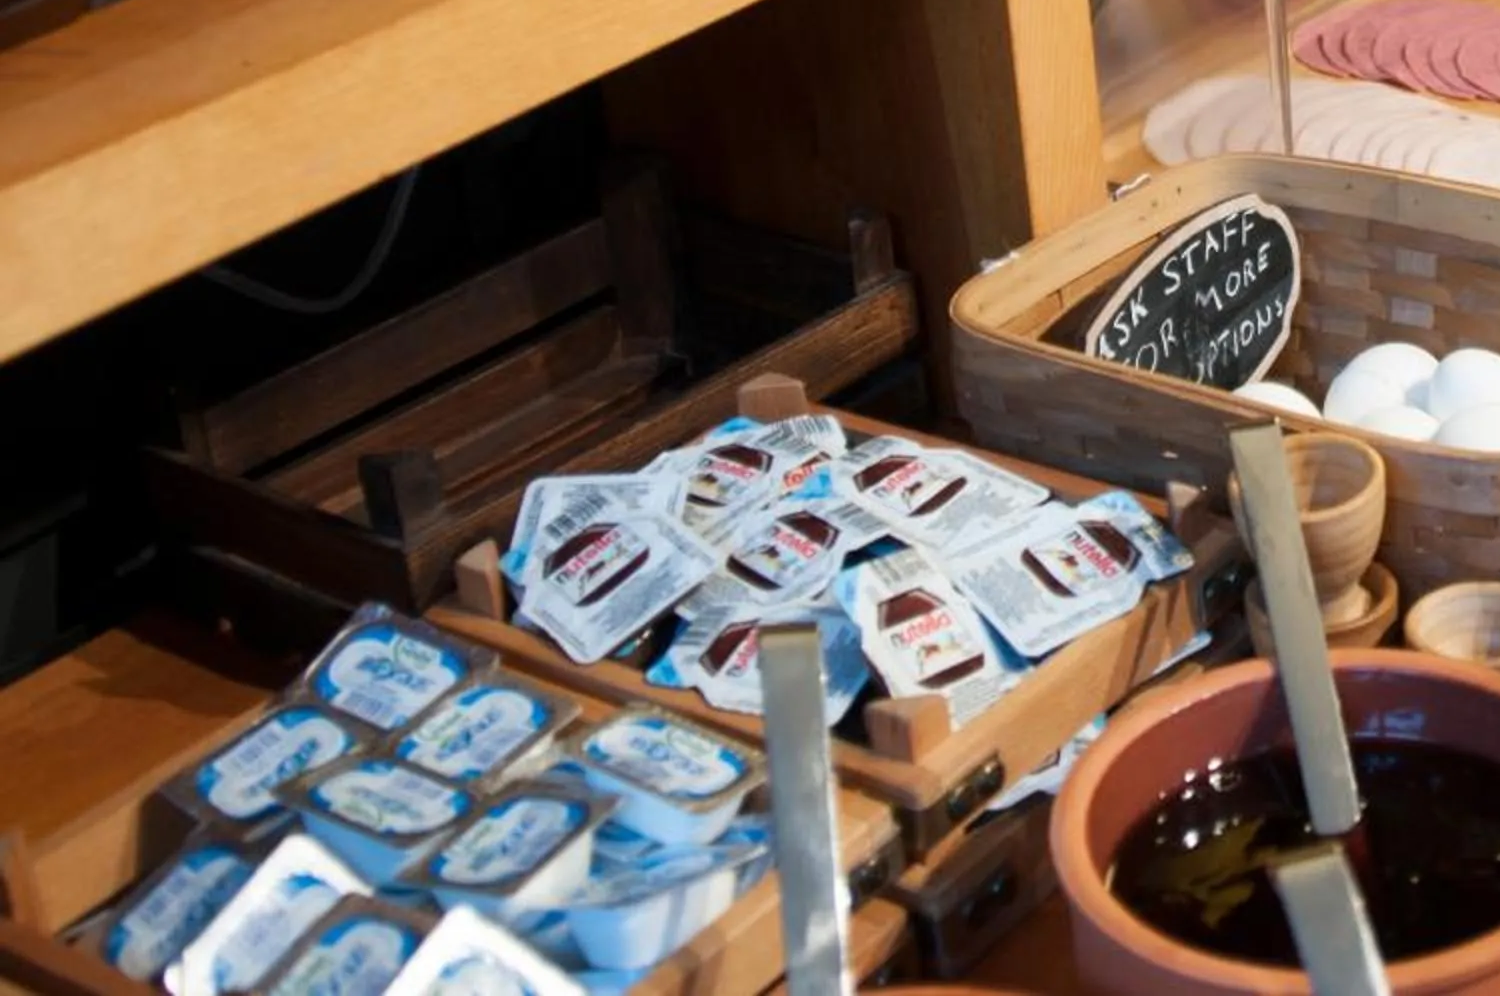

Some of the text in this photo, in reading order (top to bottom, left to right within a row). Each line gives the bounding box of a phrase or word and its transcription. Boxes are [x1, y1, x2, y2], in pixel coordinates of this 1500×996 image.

[1162, 208, 1256, 296] STAFF
[1124, 241, 1271, 374] OR MORE
[1064, 530, 1120, 579] nutella
[890, 611, 953, 647] nutella
